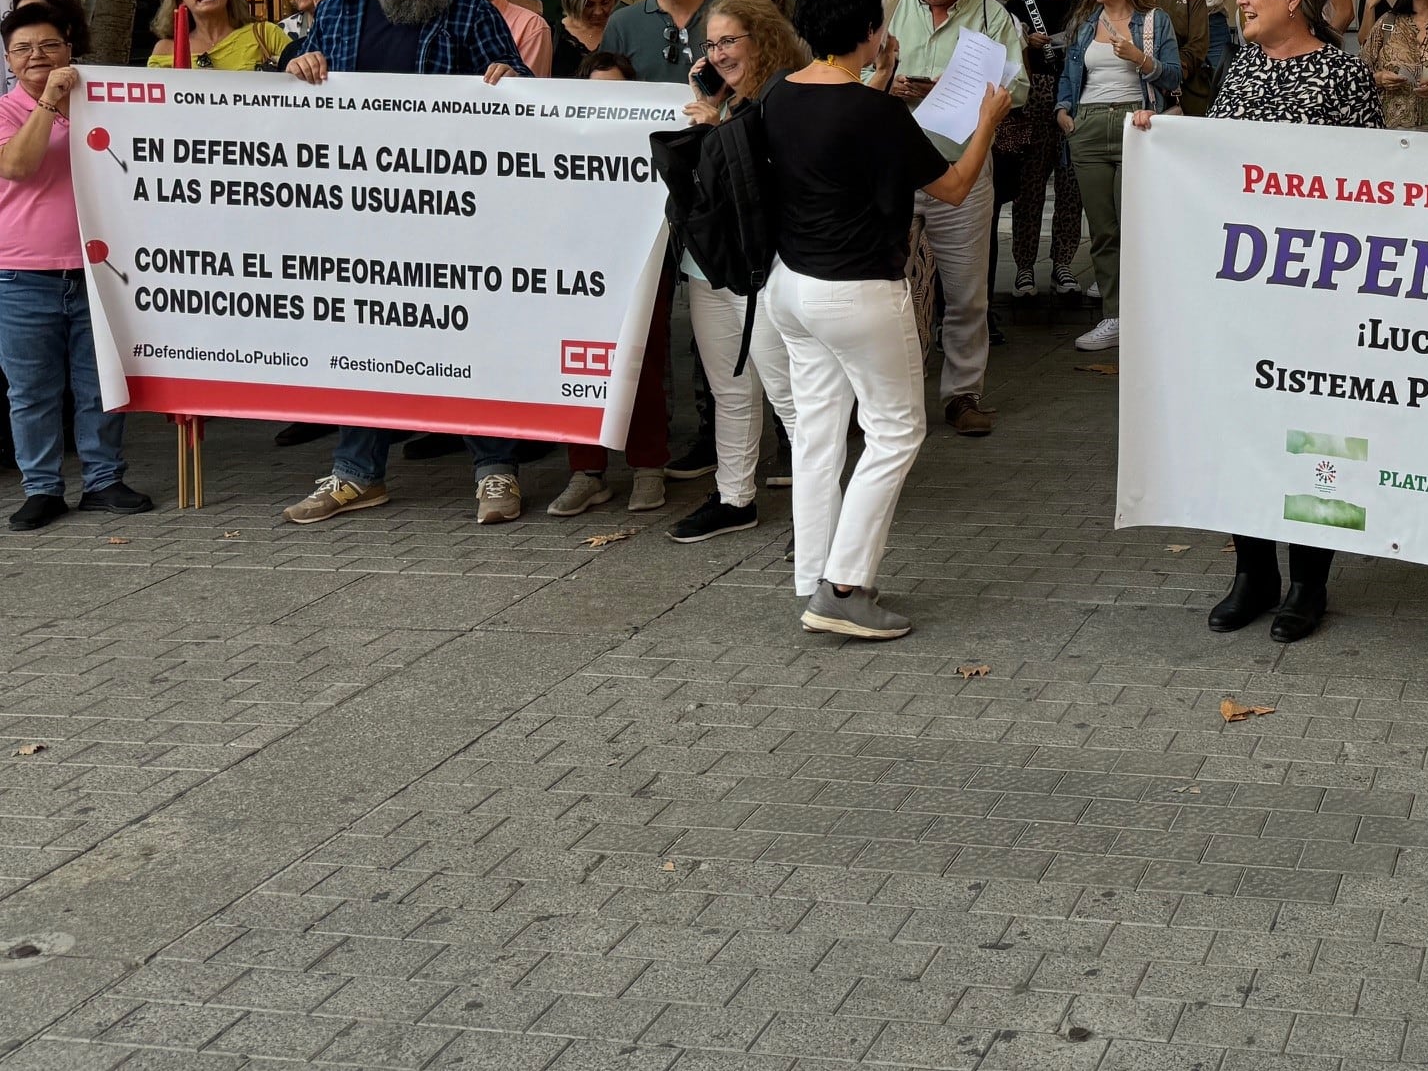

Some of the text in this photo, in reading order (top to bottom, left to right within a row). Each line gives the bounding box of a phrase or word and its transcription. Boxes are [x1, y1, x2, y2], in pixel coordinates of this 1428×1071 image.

[87, 81, 166, 104] CCOO
[174, 92, 677, 121] CON LA PLANTILLA DE LA AGENCIA ANDALUZA DE LA DEPENDENCIA
[132, 137, 164, 163] EN
[174, 139, 288, 167] DEFENSA
[297, 143, 330, 169] DE
[338, 145, 368, 171] LA
[376, 146, 488, 176] CALIDAD
[497, 151, 546, 179] DEL
[133, 177, 476, 217] A LAS PERSONAS USUARIAS
[1242, 164, 1329, 201] PARA
[1335, 177, 1396, 205] LAS
[135, 247, 606, 297] CONTRA EL EMPEORAMIENTO DE LAS
[135, 287, 469, 331] CONDICIONES DE TRABAJO
[133, 343, 472, 379] #DefendiendoLoPublico #GestionDeCalidad
[1254, 359, 1399, 405] SISTEMA
